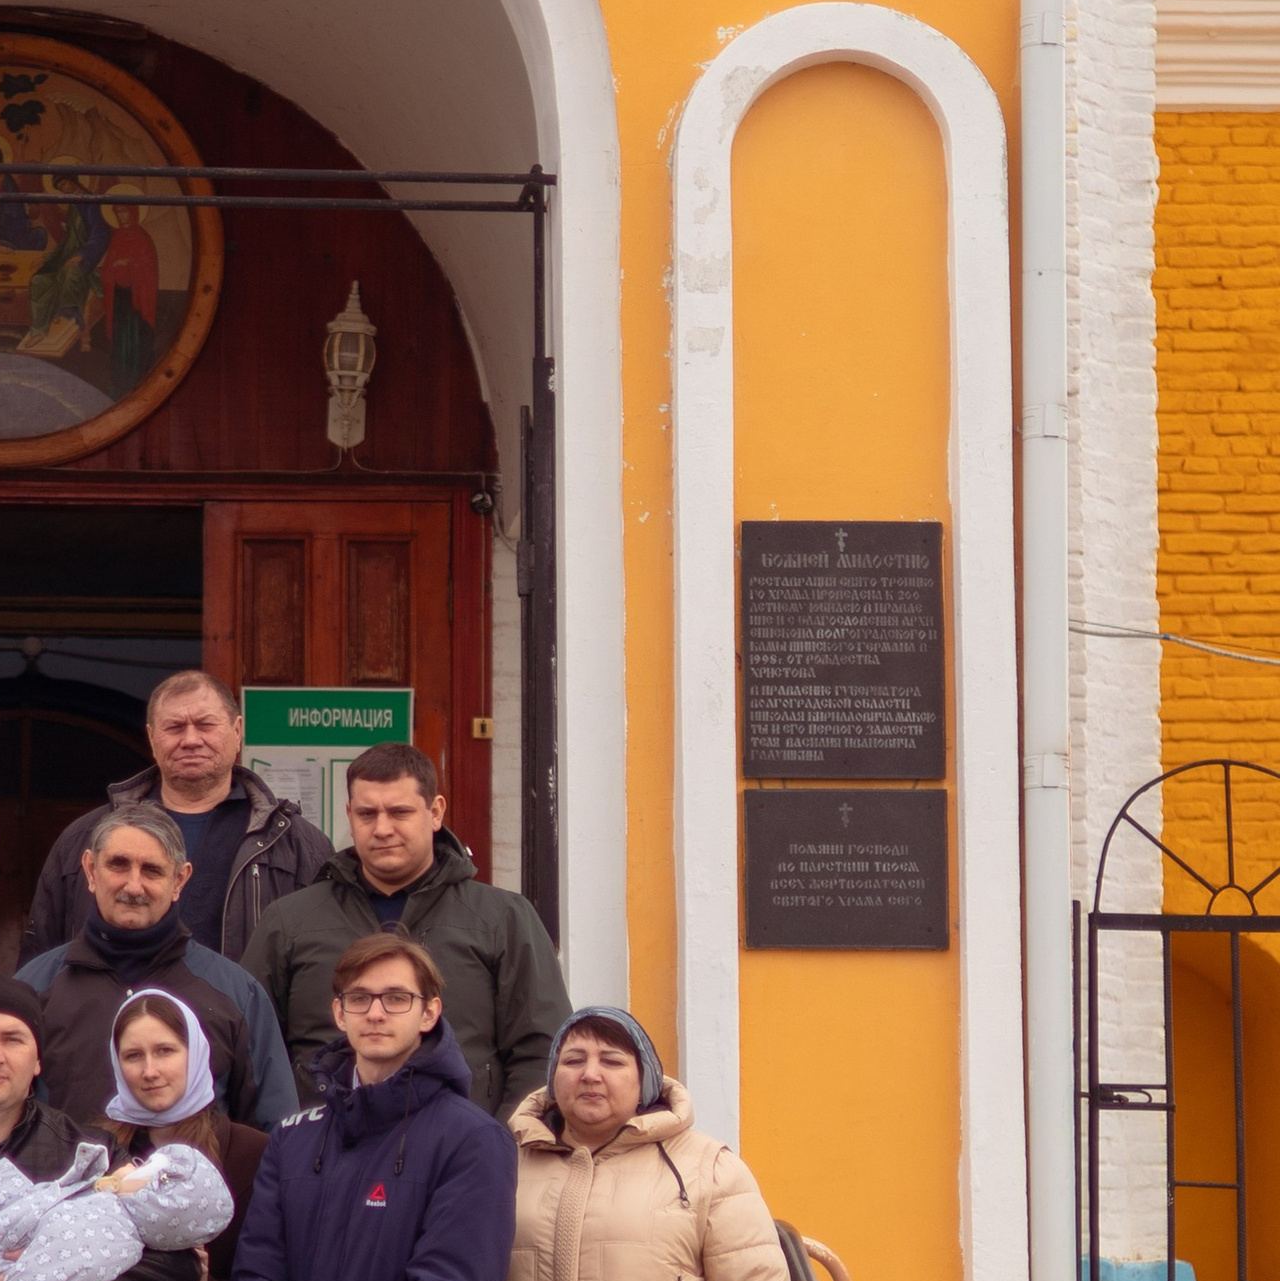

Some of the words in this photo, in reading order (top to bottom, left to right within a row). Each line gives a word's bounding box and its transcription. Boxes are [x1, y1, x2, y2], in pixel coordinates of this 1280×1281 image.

[749, 590, 765, 600] ГО
[885, 591, 893, 600] К
[864, 603, 872, 613] В
[787, 654, 803, 664] ОТ
[751, 668, 816, 678] ХРИСТОВА
[855, 699, 911, 709] ОБЛАСТИ
[289, 708, 393, 731] ИНФОРМАЦИЯ
[751, 724, 769, 735] ТЫ
[771, 725, 780, 735] И
[783, 725, 805, 735] ЕГО
[808, 724, 863, 735] ПЕРВОГО
[751, 738, 780, 747] ТЕЛЯ
[778, 862, 796, 872] ВО
[874, 862, 919, 872] ТВОЕМ
[770, 879, 806, 889] ВСЕХ
[837, 896, 883, 906] ХРАМА
[888, 896, 923, 906] СЕГО
